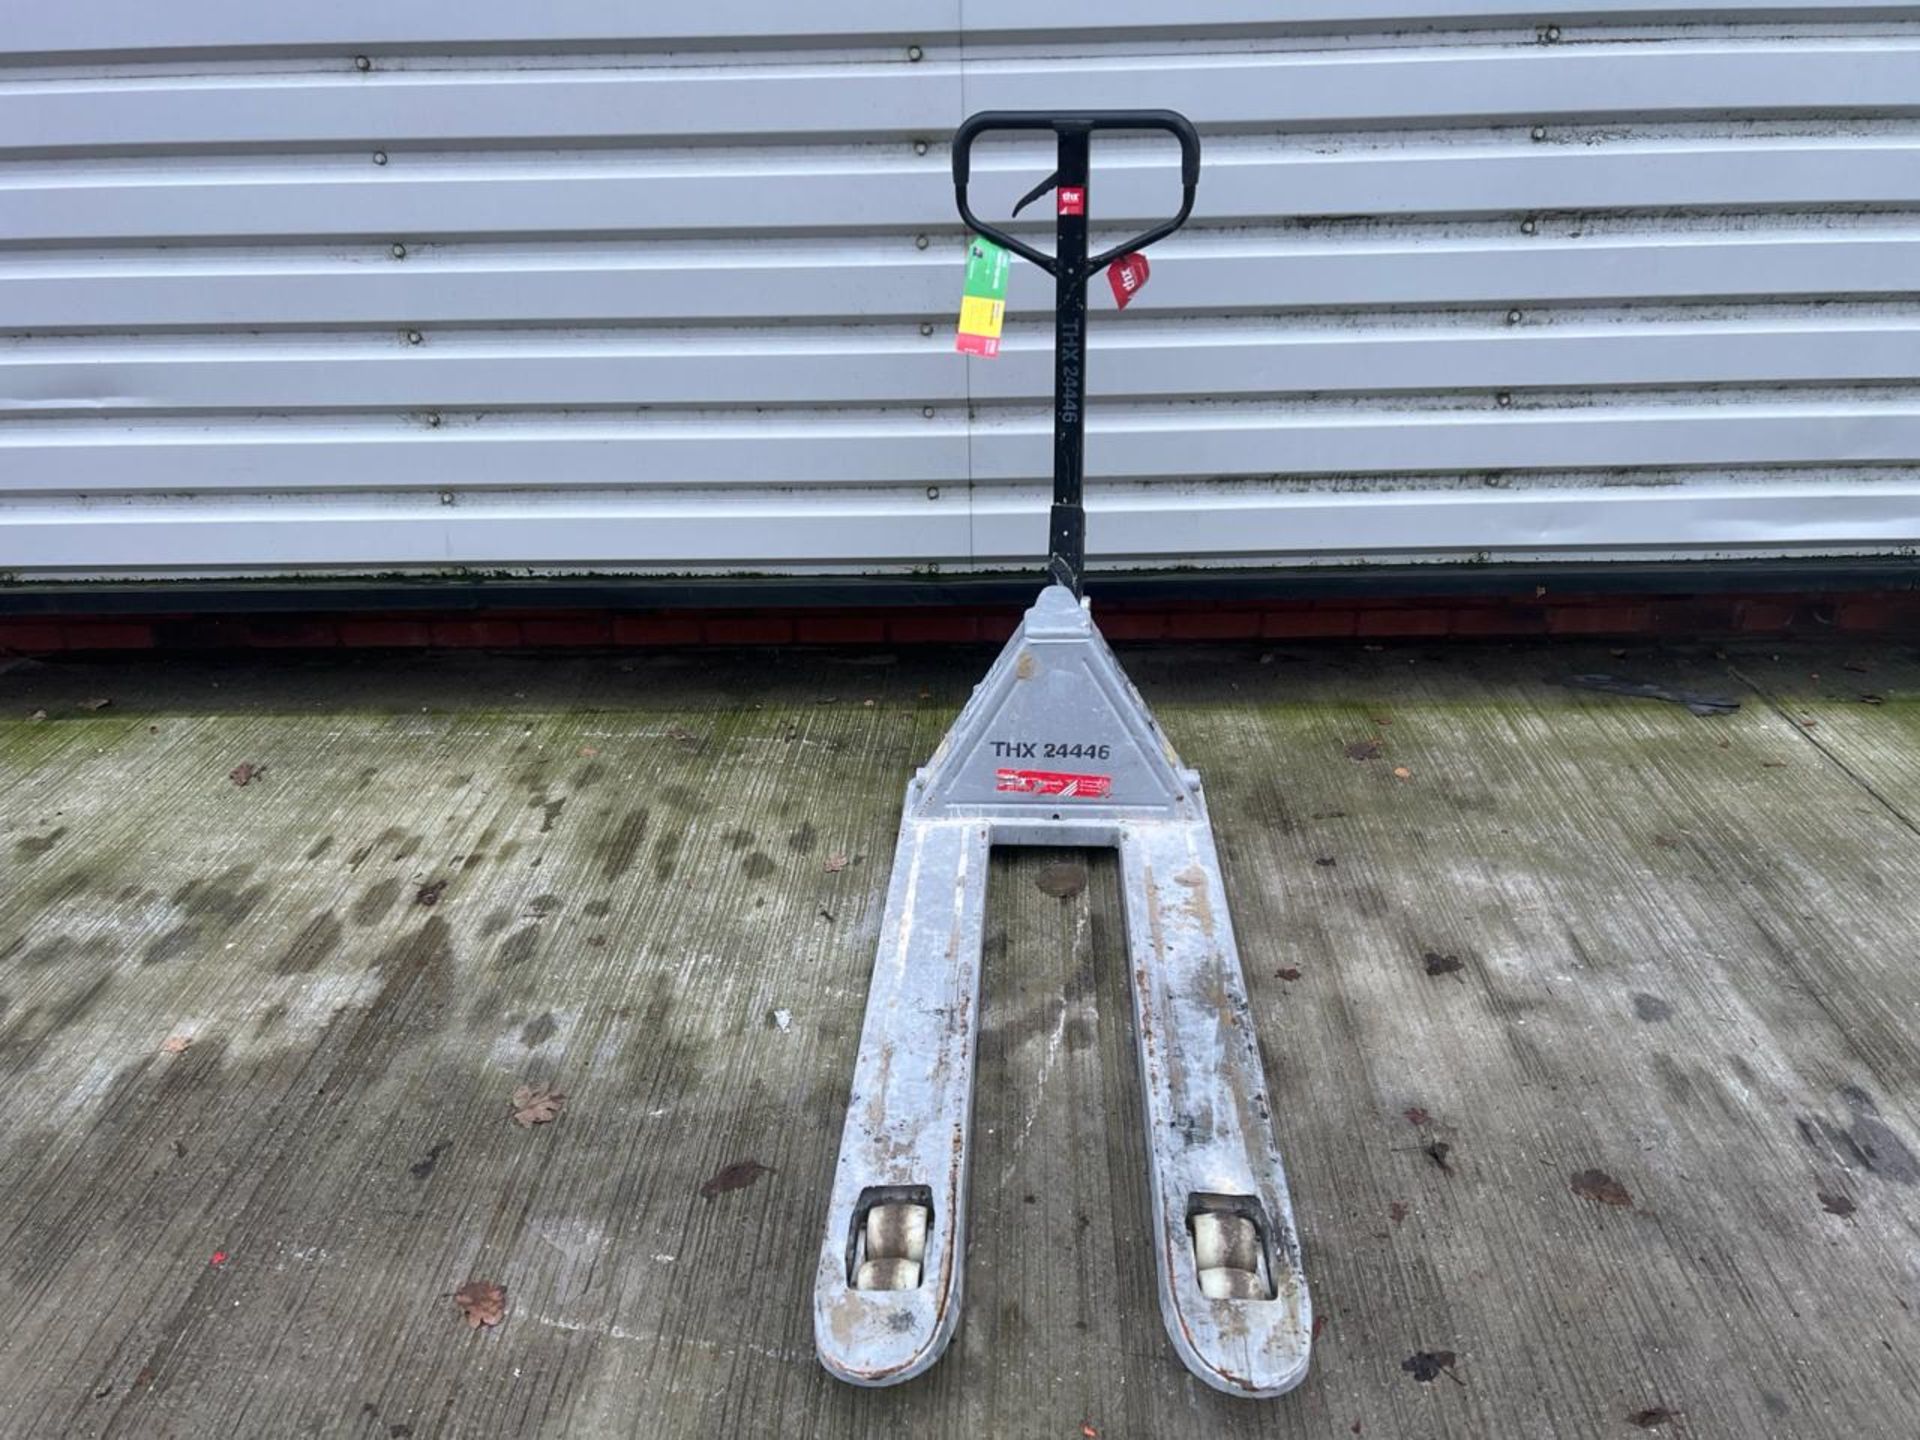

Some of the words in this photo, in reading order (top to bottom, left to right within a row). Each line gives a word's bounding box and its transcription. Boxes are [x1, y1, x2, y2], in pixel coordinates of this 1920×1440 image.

[1062, 319, 1080, 361] THX
[1061, 366, 1080, 423] 24446
[990, 741, 1037, 758] THX
[1043, 743, 1111, 760] 24446
